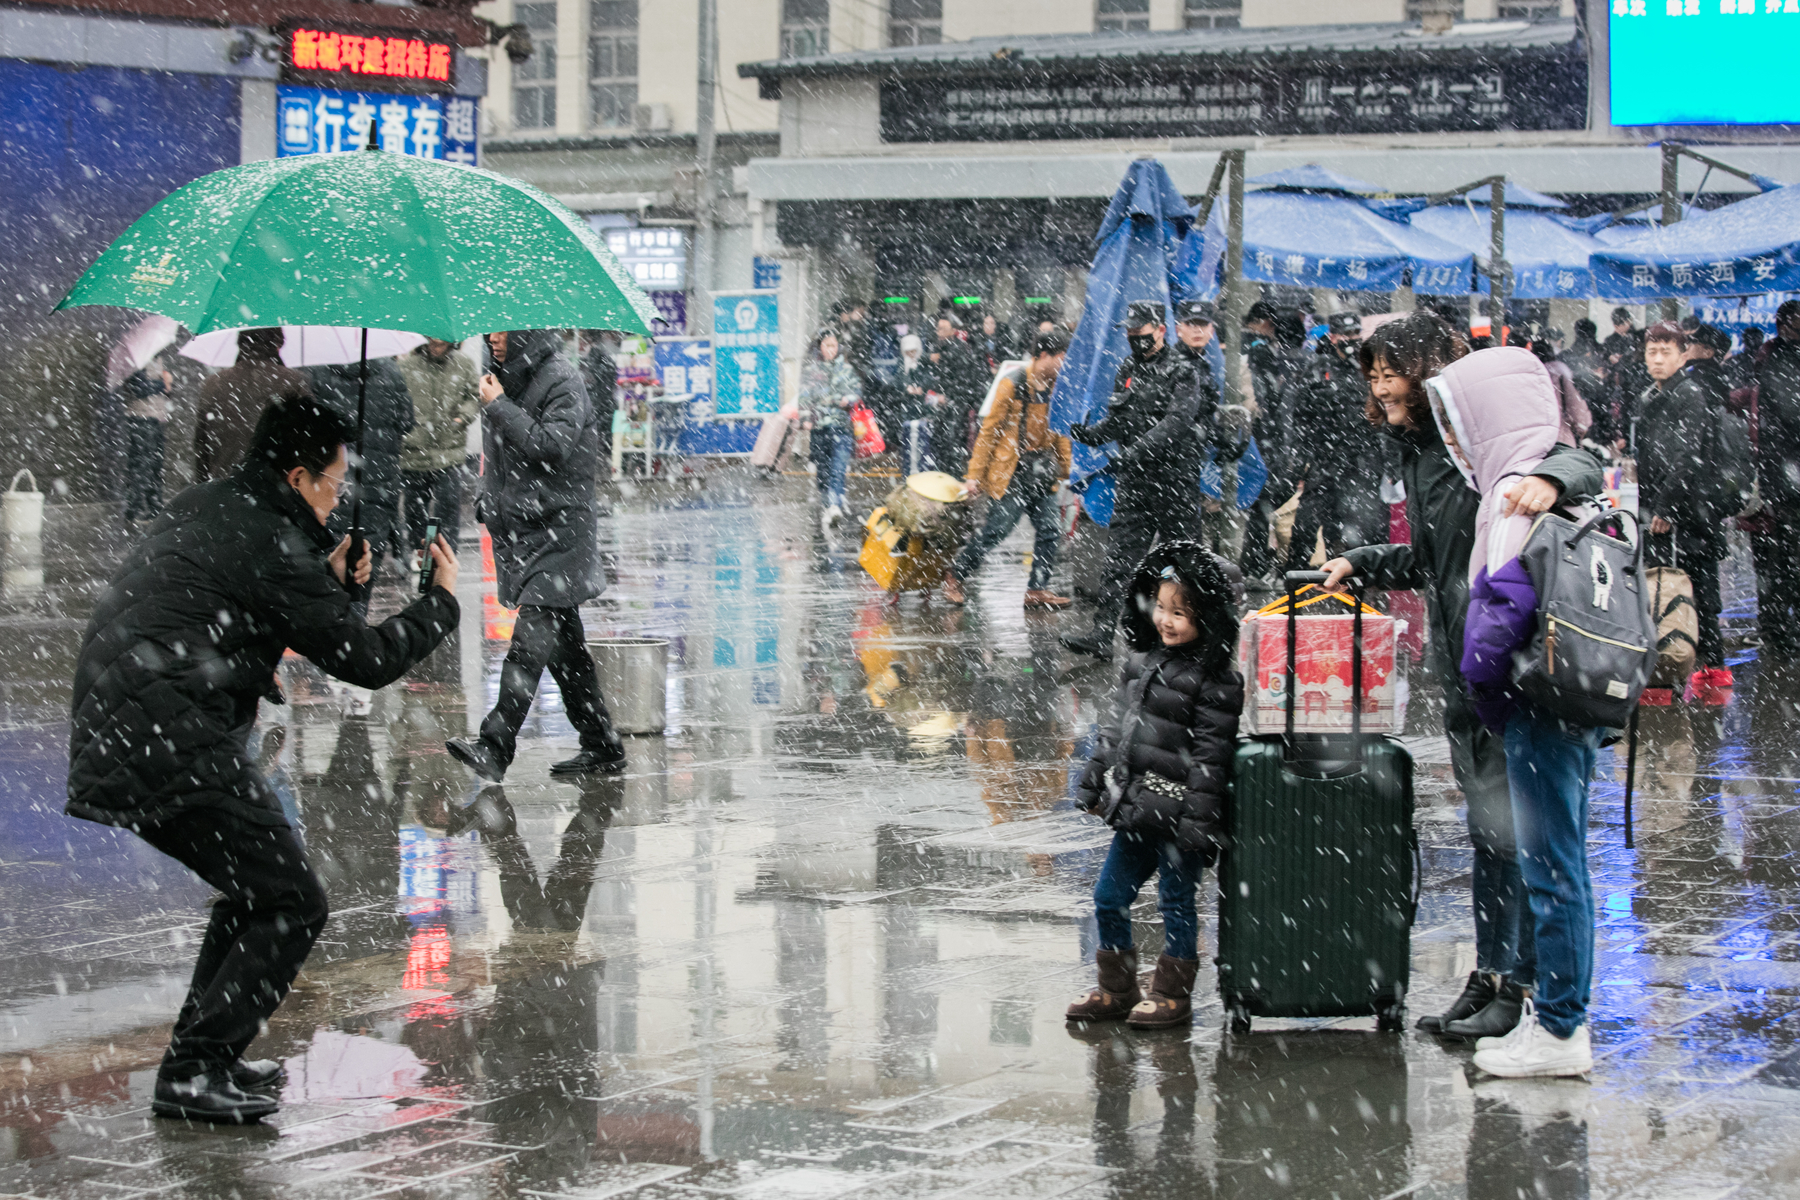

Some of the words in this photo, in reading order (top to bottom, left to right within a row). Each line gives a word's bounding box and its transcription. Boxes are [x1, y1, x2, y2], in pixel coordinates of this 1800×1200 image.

[292, 28, 451, 81] 新城环建招待所
[314, 94, 441, 159] 行李寄存
[1256, 251, 1368, 280] 和谐广场
[1632, 258, 1777, 288] 品质西安
